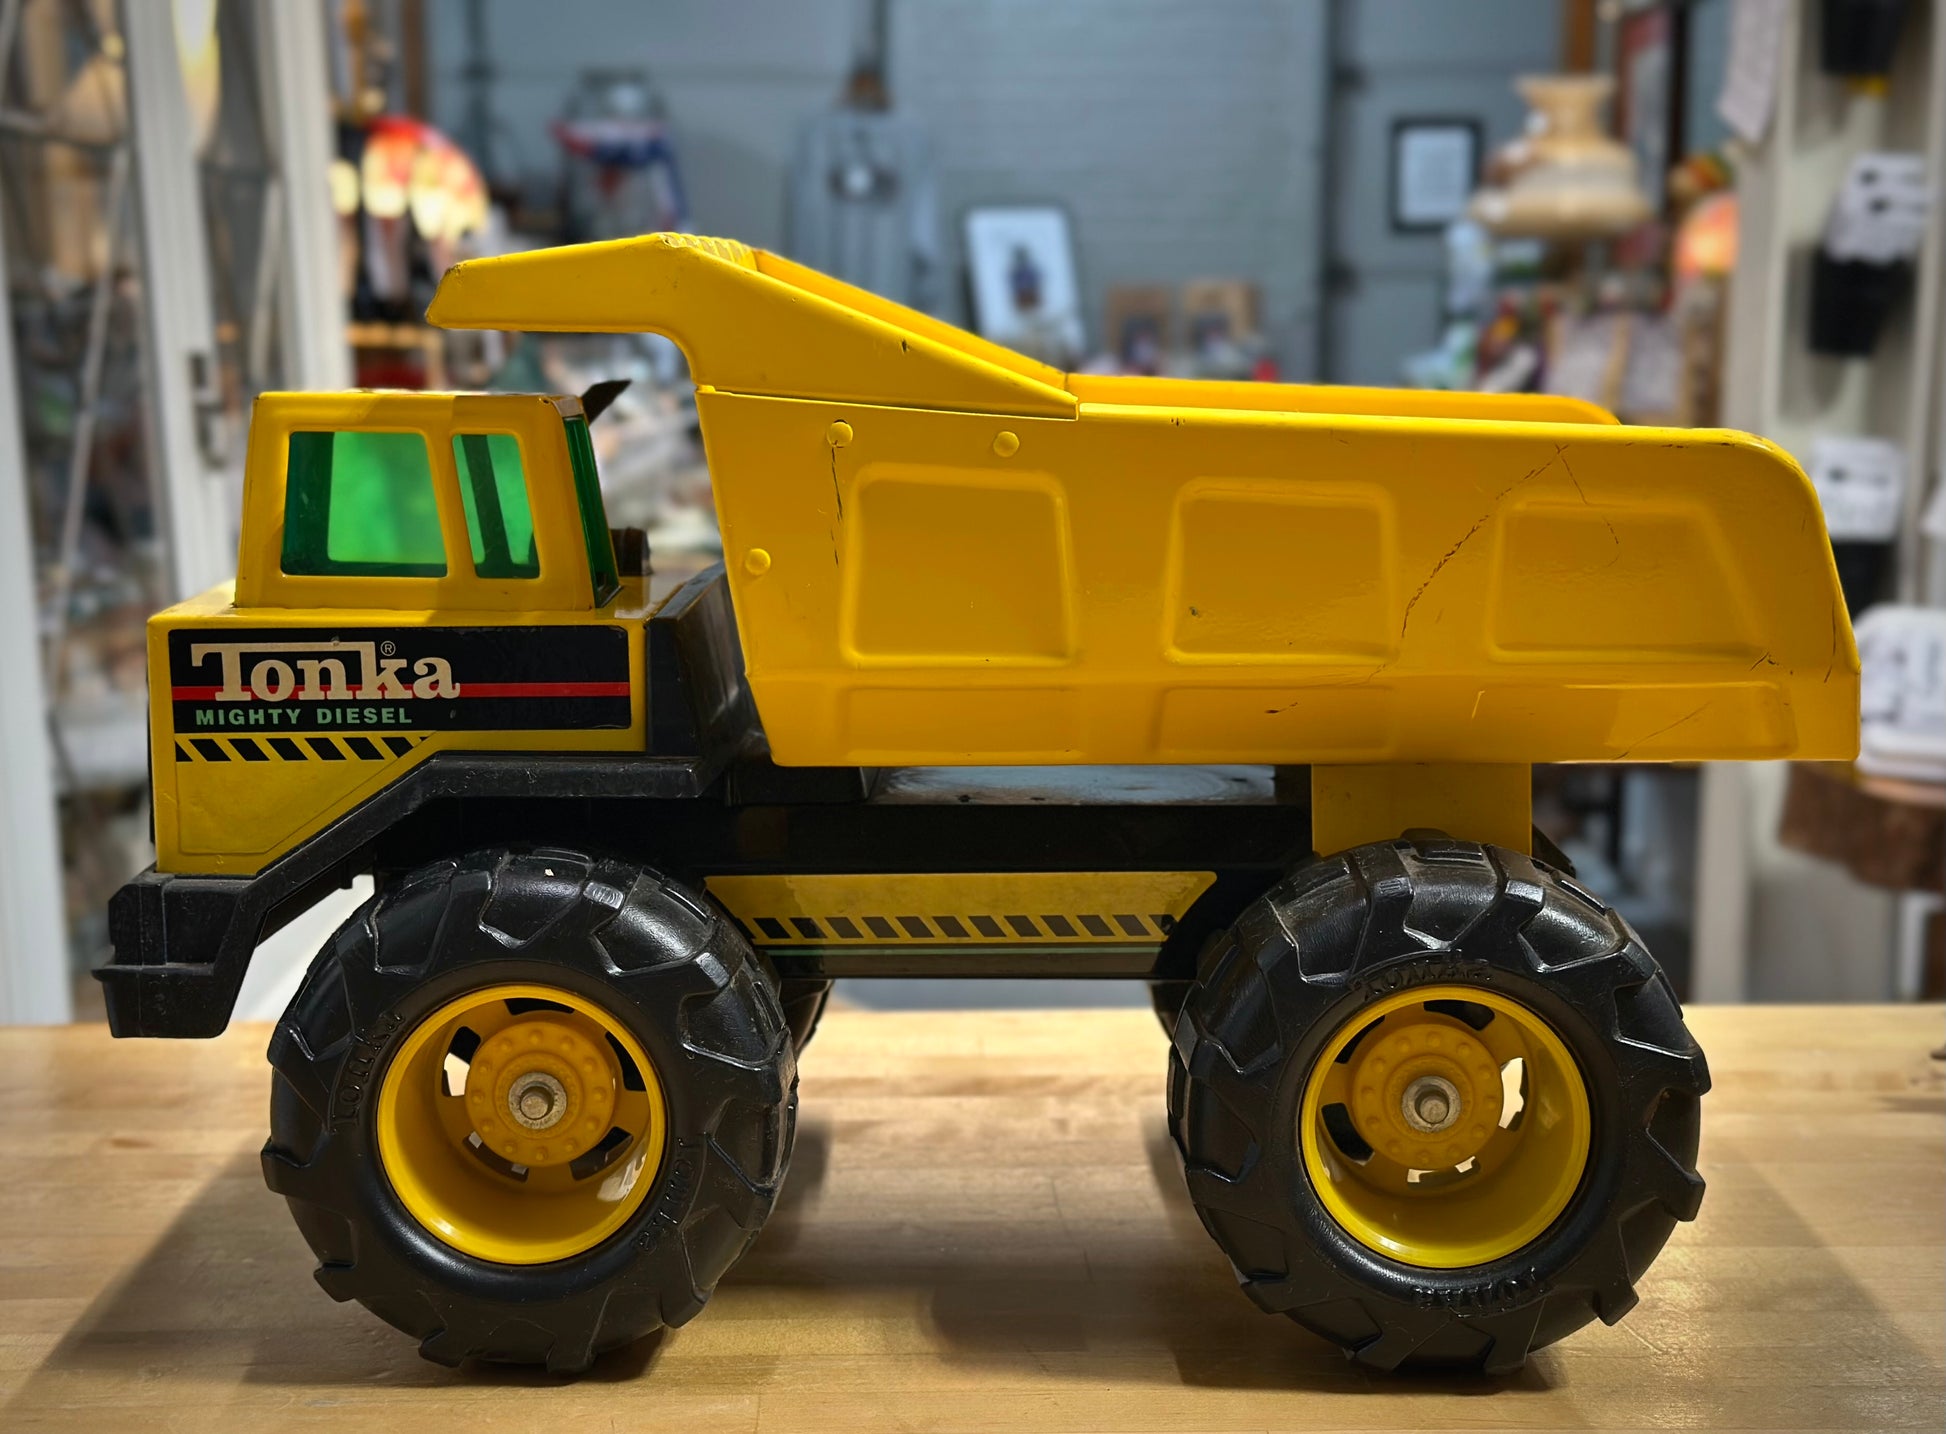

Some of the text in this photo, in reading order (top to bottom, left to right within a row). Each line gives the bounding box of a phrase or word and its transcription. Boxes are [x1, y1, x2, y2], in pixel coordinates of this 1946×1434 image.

[191, 641, 461, 702] Tonka
[195, 707, 413, 726] MIGHTY DIESEL
